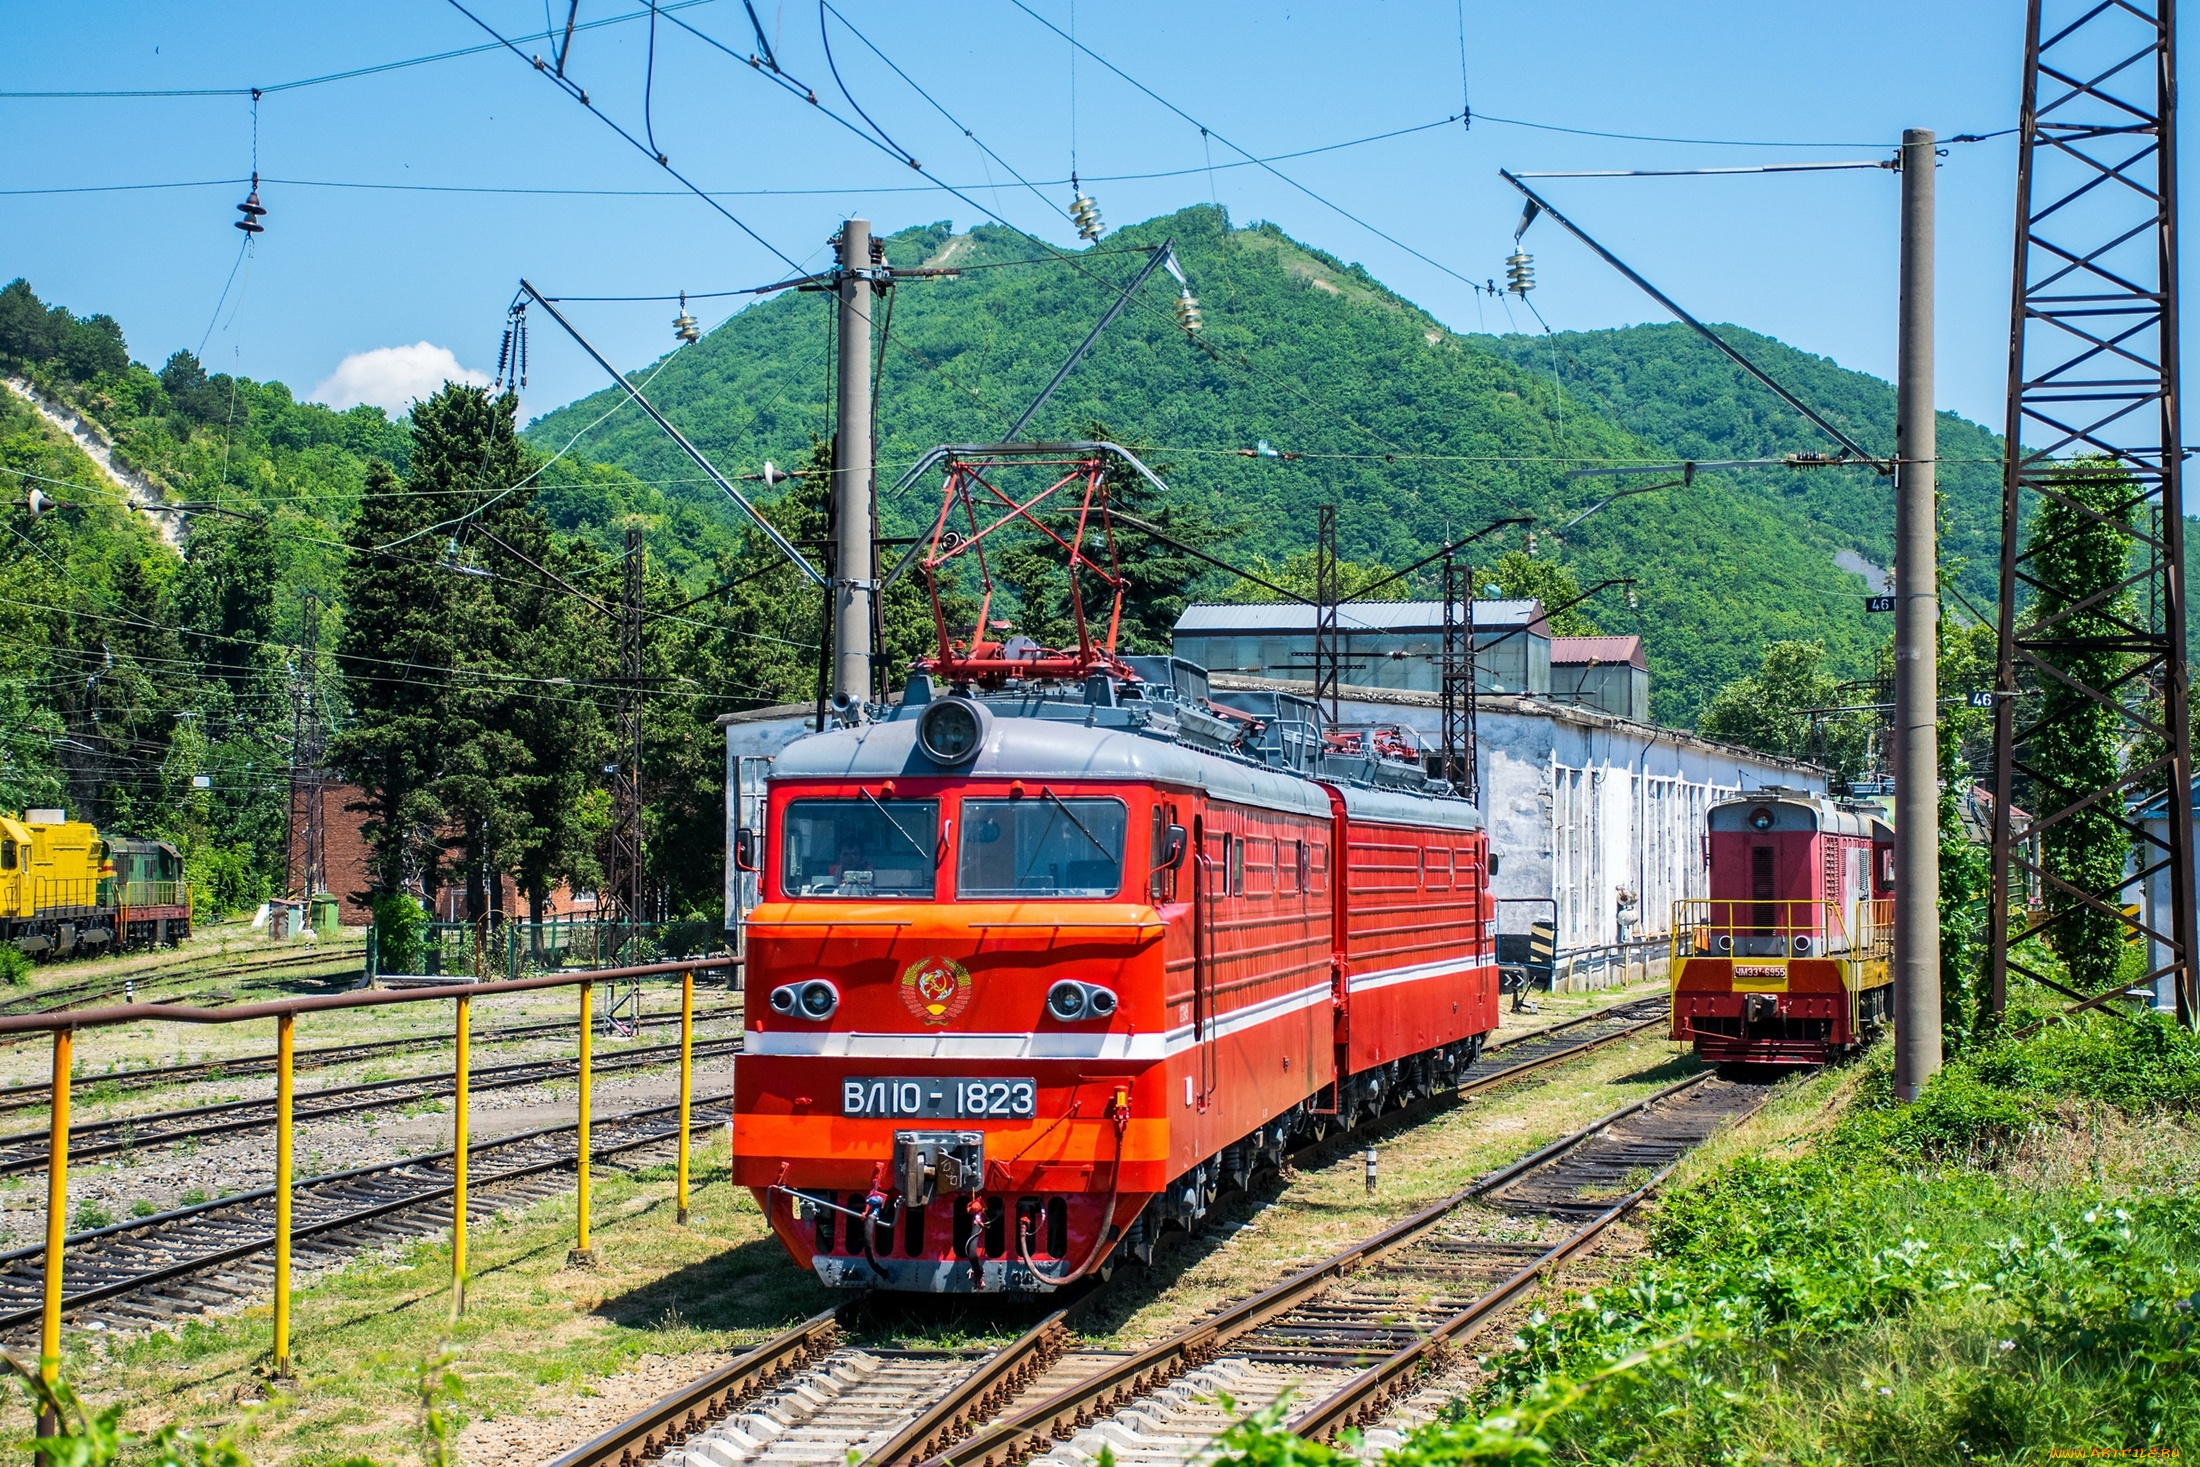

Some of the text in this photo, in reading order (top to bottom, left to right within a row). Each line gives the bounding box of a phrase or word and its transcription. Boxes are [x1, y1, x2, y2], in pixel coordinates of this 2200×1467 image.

[1871, 598, 1889, 611] 46
[1973, 693, 1992, 706] 46
[844, 1082, 921, 1113] ВЛ10
[957, 1082, 1033, 1113] 1823
